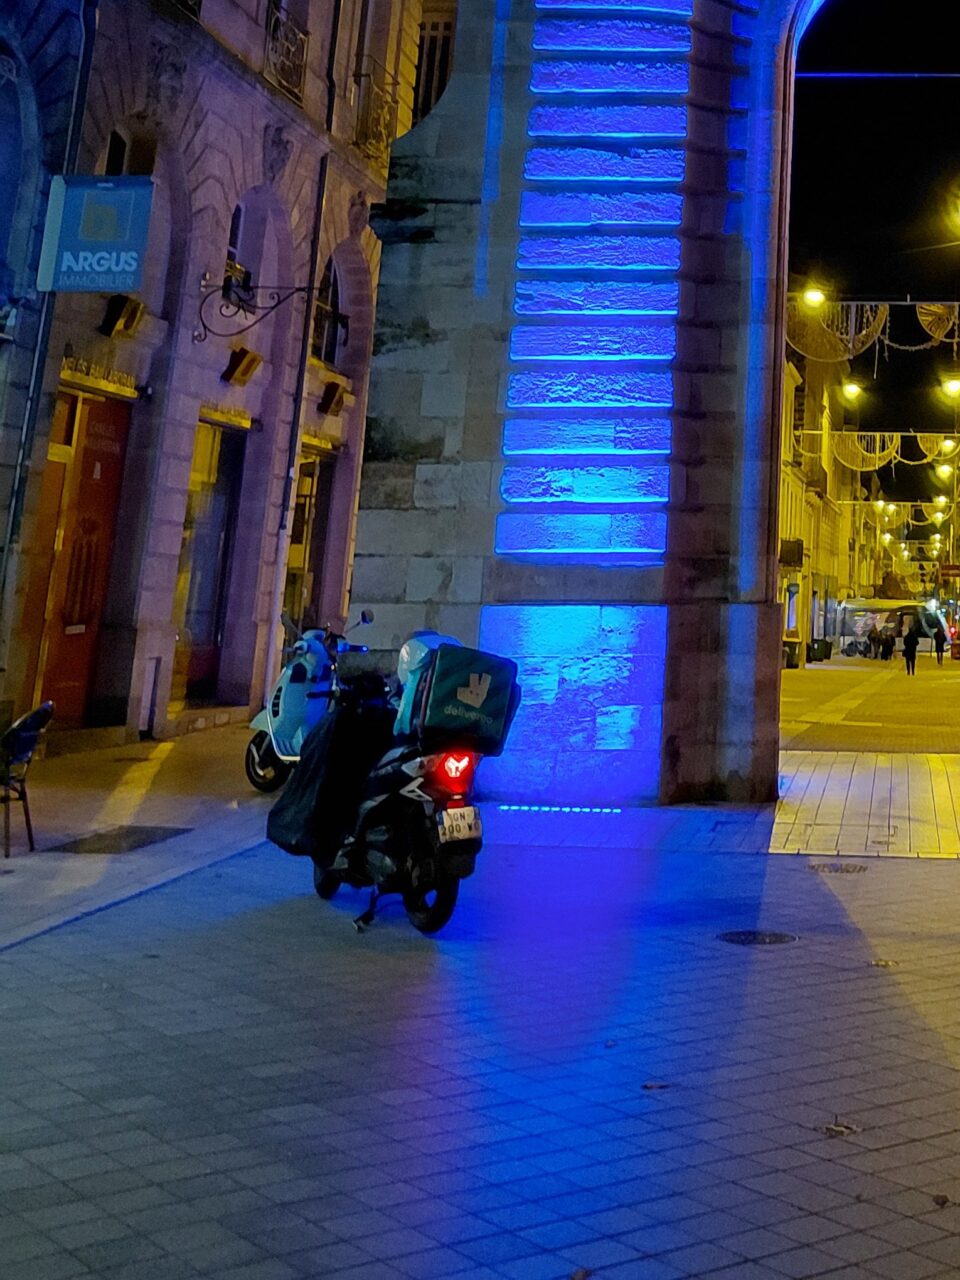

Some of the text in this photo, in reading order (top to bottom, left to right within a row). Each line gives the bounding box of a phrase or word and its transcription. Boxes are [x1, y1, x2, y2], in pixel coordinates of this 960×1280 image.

[61, 251, 138, 273] ARGUS
[58, 273, 134, 288] IMMOBILIER
[444, 705, 493, 724] deliveroo
[441, 823, 462, 836] 200
